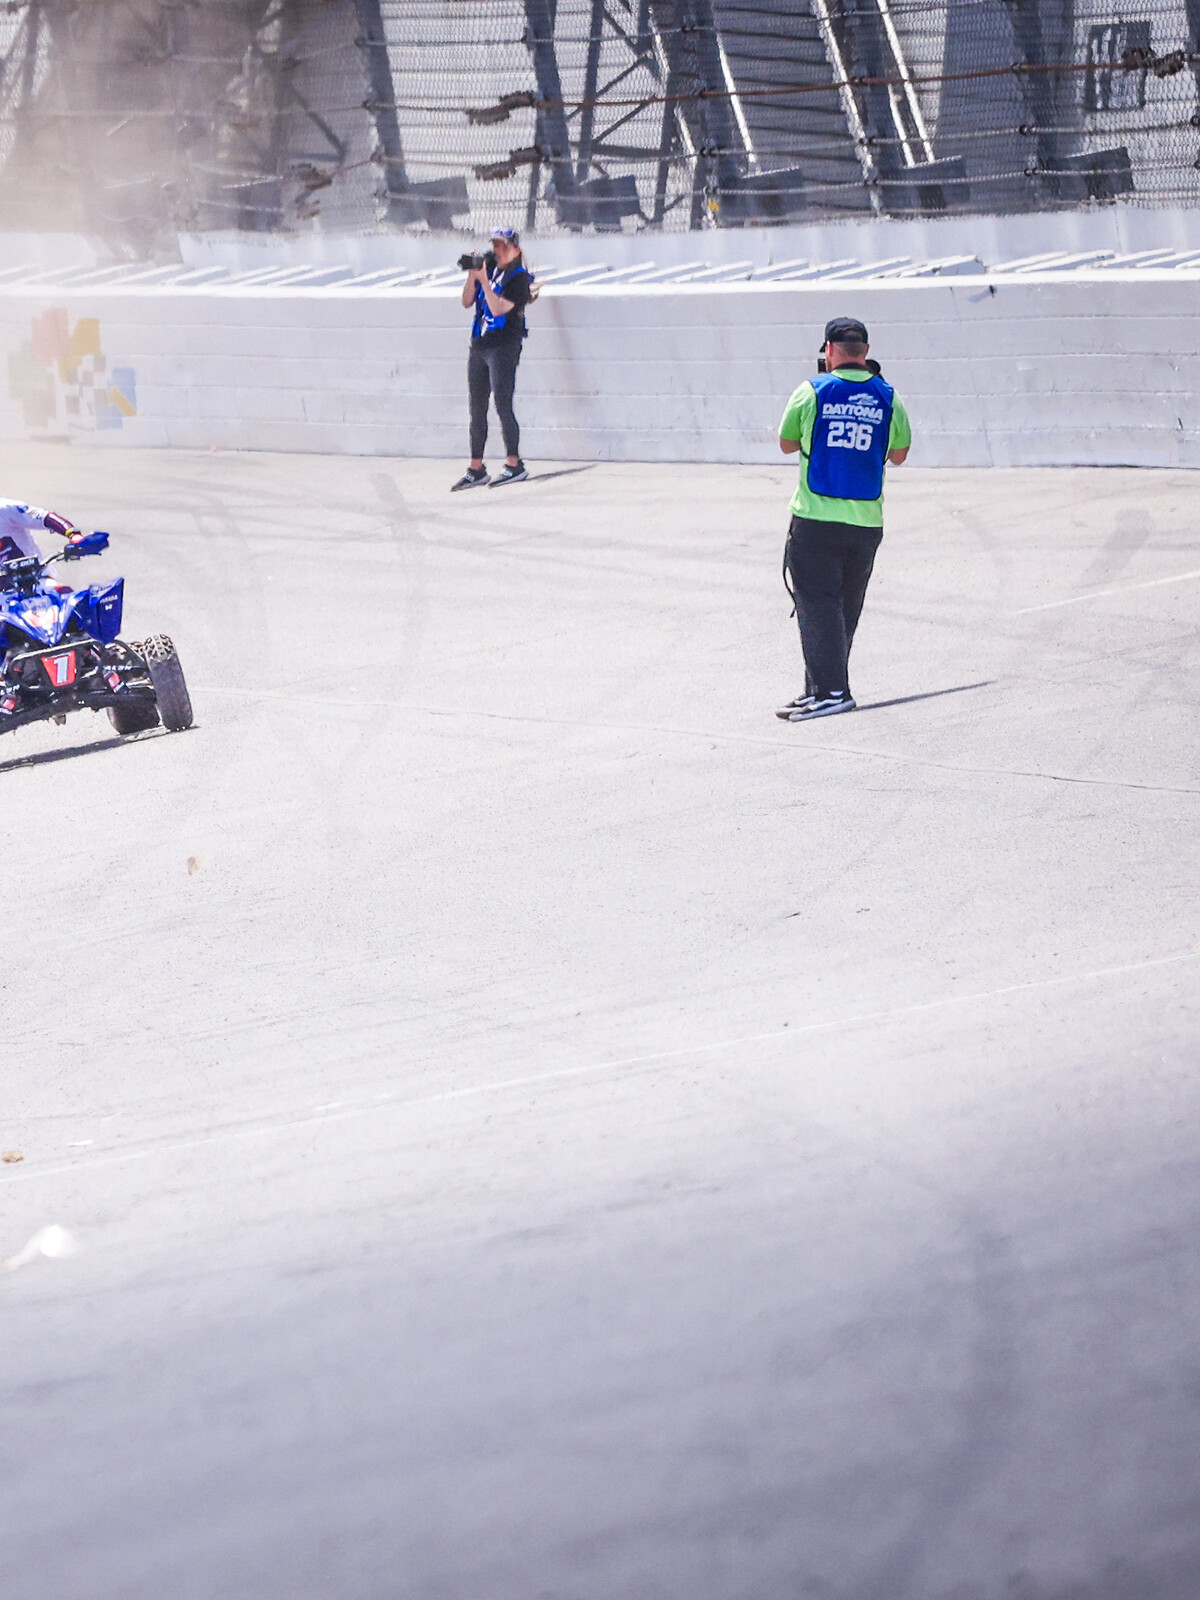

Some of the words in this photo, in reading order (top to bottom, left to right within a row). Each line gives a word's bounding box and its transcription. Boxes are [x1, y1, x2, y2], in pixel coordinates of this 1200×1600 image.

[822, 403, 884, 420] DAYTONA
[826, 420, 874, 451] 236
[53, 656, 69, 684] 1
